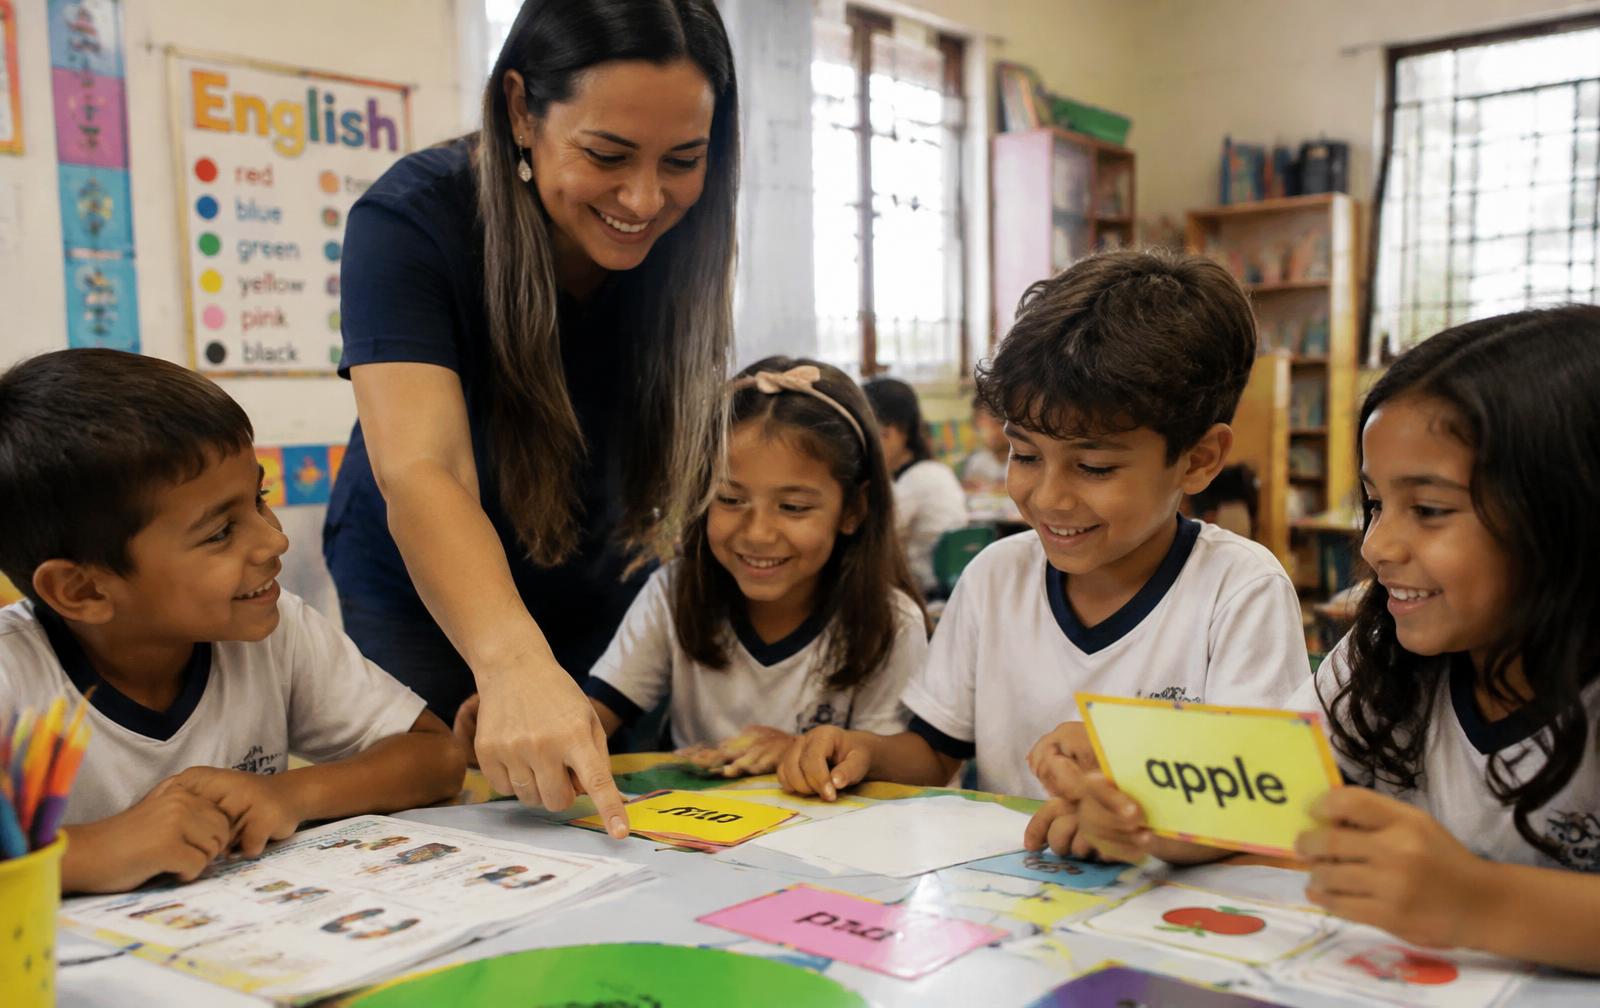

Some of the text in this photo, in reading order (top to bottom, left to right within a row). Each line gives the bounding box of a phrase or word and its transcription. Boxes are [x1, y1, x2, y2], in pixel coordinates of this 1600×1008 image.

[190, 70, 398, 158] English
[235, 164, 273, 187] red
[236, 200, 281, 224] blue
[237, 239, 300, 263] green
[238, 271, 304, 297] yellow
[241, 307, 287, 332] pink
[243, 341, 297, 363] black
[1146, 756, 1287, 808] apple
